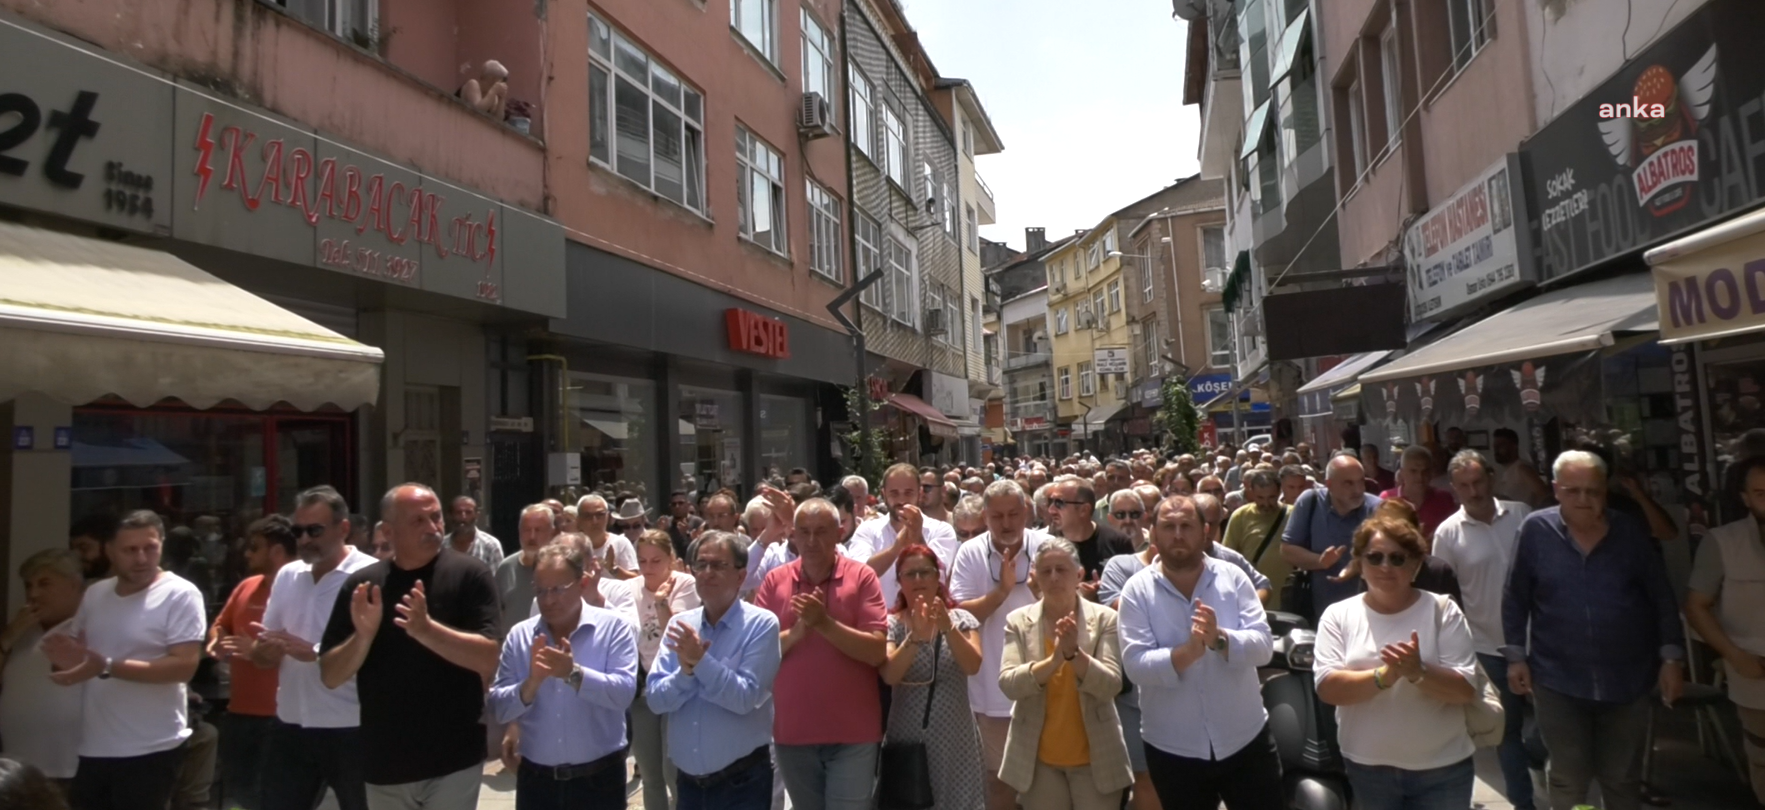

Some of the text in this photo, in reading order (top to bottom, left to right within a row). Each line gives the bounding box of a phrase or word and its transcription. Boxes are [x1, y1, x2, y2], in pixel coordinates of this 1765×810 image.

[221, 126, 449, 259] KARABACAK
[1546, 167, 1576, 199] SOKAK
[1636, 145, 1696, 200] ALBATROS
[731, 308, 792, 359] VESTEL
